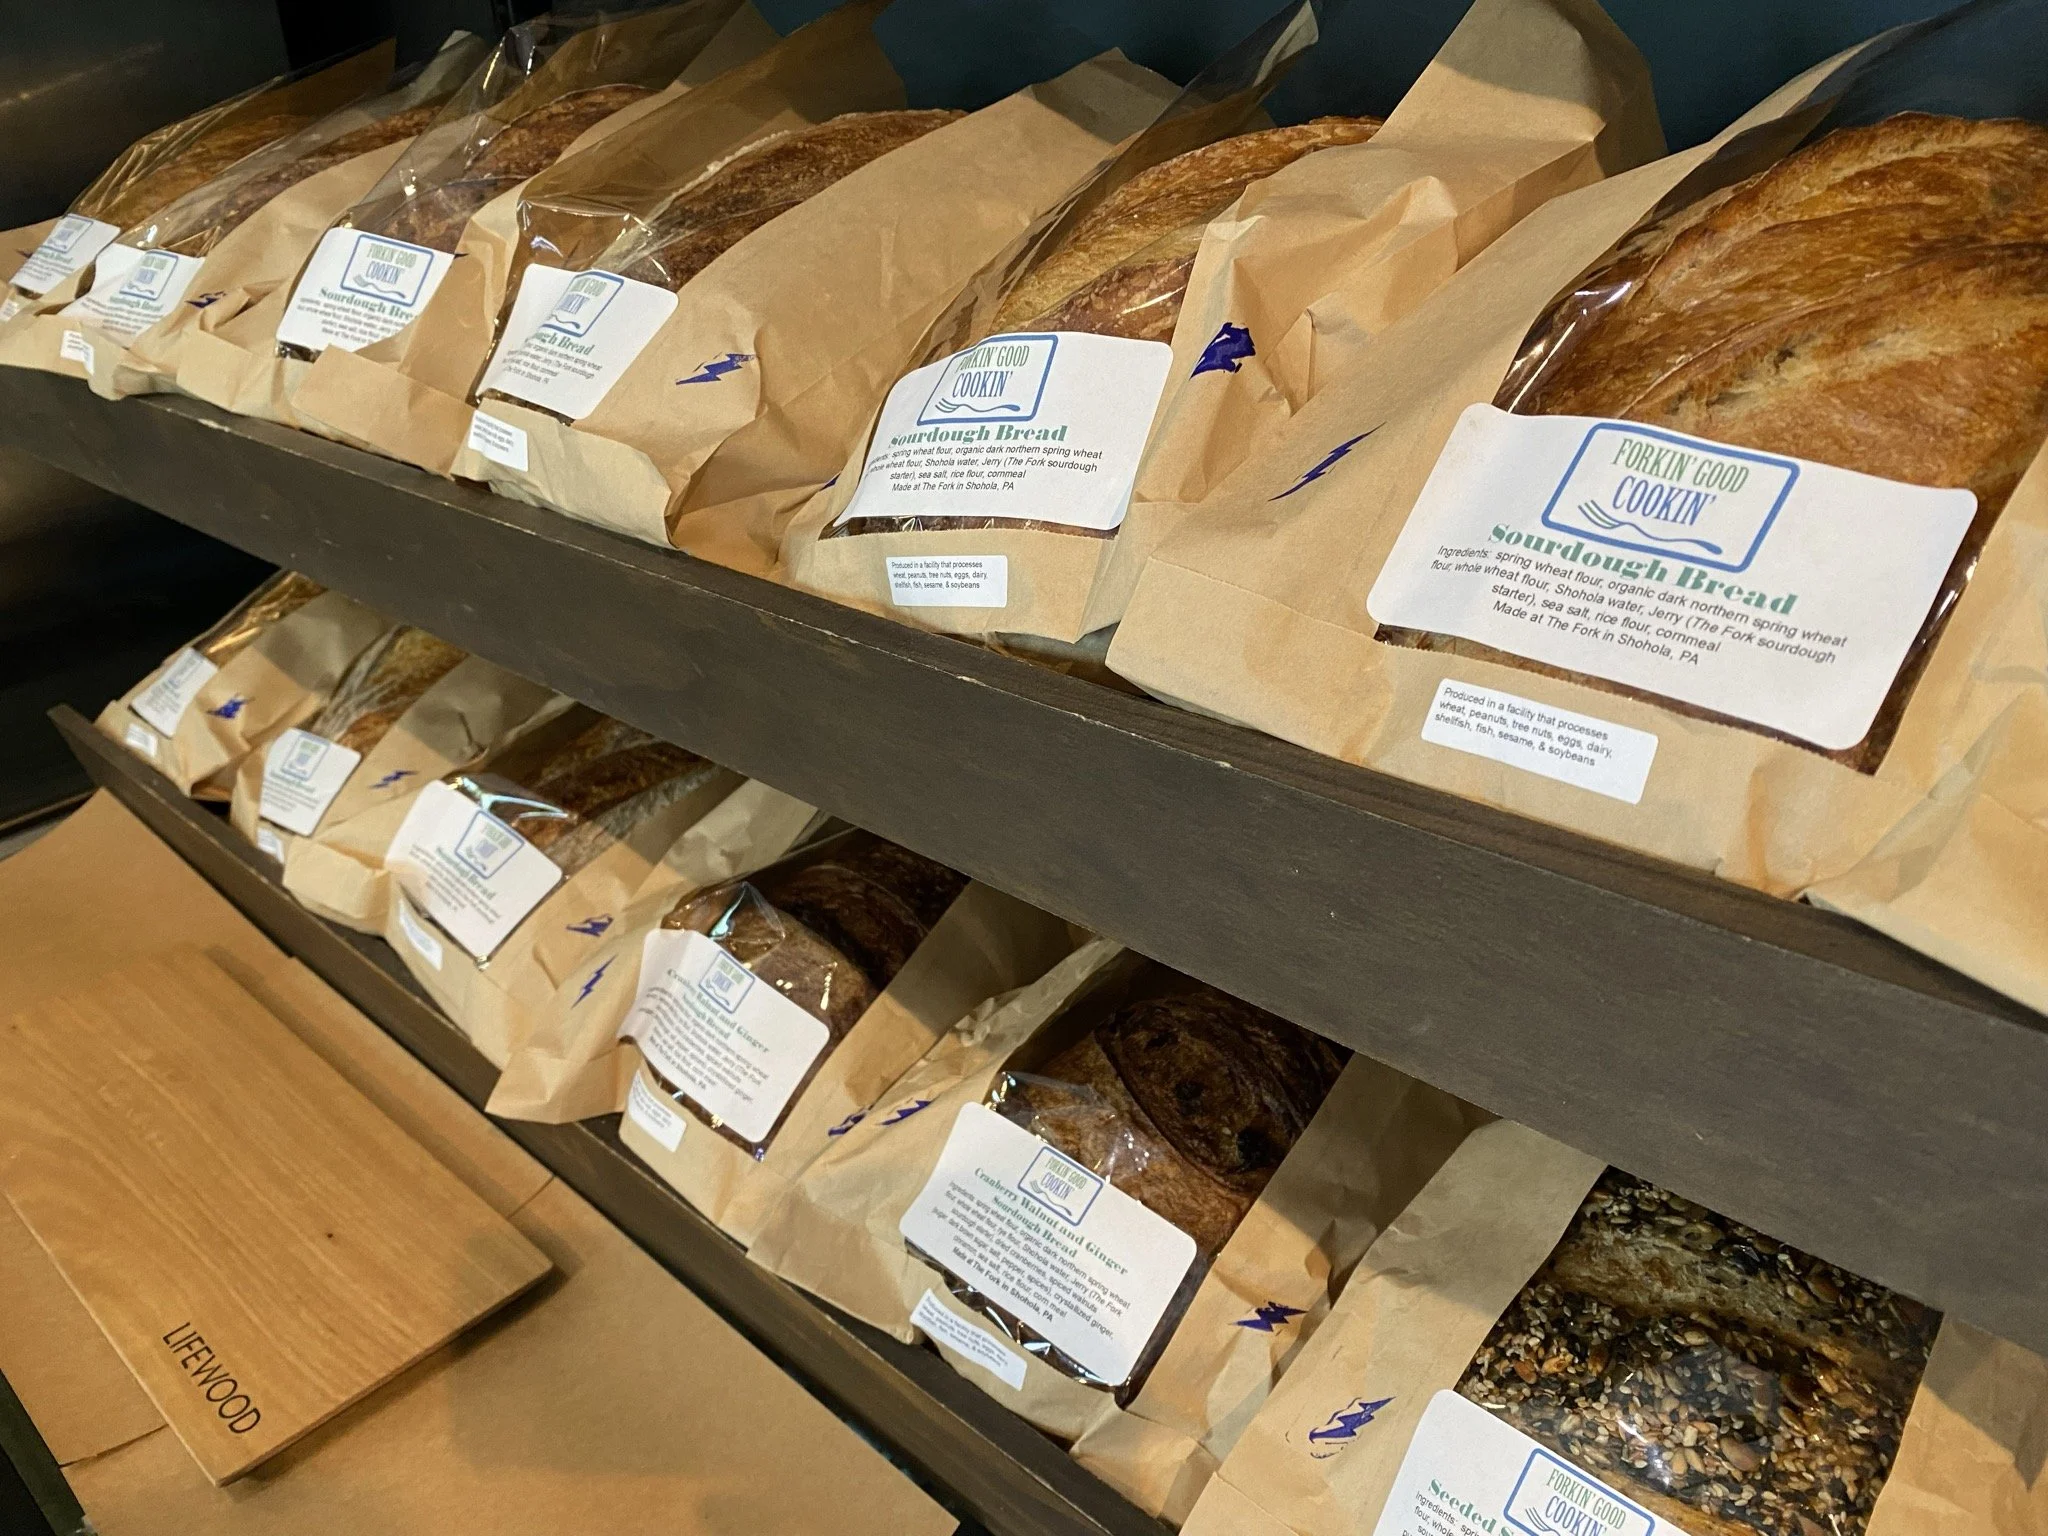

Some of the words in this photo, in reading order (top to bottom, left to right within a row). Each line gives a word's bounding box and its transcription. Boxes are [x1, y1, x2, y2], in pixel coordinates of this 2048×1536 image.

[558, 336, 595, 356] Bread
[996, 345, 1030, 368] GOOD
[952, 371, 1014, 398] COOKIN'
[888, 425, 990, 449] Sourdough
[995, 424, 1068, 442] Bread
[912, 446, 935, 456] wheat
[935, 446, 953, 456] flour,
[955, 445, 985, 456] organic
[985, 444, 1004, 454] dark
[1005, 445, 1041, 454] northern
[1042, 446, 1071, 458] spring
[1073, 448, 1103, 460] wheat
[892, 482, 912, 492] Made
[912, 482, 921, 491] at
[922, 481, 937, 490] The
[937, 481, 956, 490] Fork
[955, 481, 964, 490] in
[965, 481, 1000, 491] Shohola,
[1002, 481, 1014, 490] PA
[906, 459, 923, 468] flour,
[924, 458, 955, 467] Shohola
[956, 458, 979, 467] water,
[981, 457, 1003, 468] Jerry
[1003, 457, 1024, 468] (The
[1024, 457, 1047, 467] Fork
[1047, 460, 1098, 472] sourdough
[932, 470, 948, 479] salt,
[950, 469, 965, 478] rice
[966, 469, 985, 479] flour,
[1611, 438, 1698, 482] FORKIN'
[1692, 458, 1750, 493] GOOD
[1612, 475, 1717, 526] COOKIN'
[940, 560, 952, 568] that
[952, 561, 983, 569] processes
[945, 580, 950, 588] &
[950, 581, 980, 590] soybeans
[1488, 524, 1668, 583] Sourdough
[1674, 566, 1798, 616] Bread
[1430, 559, 1453, 572] flour,
[1454, 561, 1483, 573] whole
[1483, 565, 1520, 582] wheat
[1520, 573, 1550, 593] flour,
[1554, 583, 1605, 604] Shohola
[1608, 597, 1645, 616] water,
[1648, 606, 1684, 626] Jerry
[1685, 615, 1720, 634] (The
[1720, 625, 1756, 644] Fork
[1756, 637, 1836, 664] sourdough
[1437, 545, 1492, 559] Ingredients:
[1495, 552, 1533, 570] spring
[1534, 561, 1574, 580] wheat
[1574, 571, 1604, 589] flour,
[1607, 580, 1656, 599] organic
[1657, 590, 1688, 608] dark
[1689, 600, 1750, 624] northern
[1752, 618, 1799, 639] spring
[1801, 630, 1848, 648] wheat
[1491, 584, 1536, 607] starter),
[1540, 599, 1564, 612] sea
[1566, 606, 1591, 621] salt,
[1594, 611, 1618, 626] rice
[1620, 616, 1652, 636] flour,
[1655, 627, 1722, 652] cornmeal
[1492, 600, 1528, 619] Made
[1529, 613, 1544, 624] at
[1547, 615, 1570, 631] The
[1571, 622, 1602, 639] Fork
[1602, 629, 1615, 642] in
[1617, 632, 1673, 660] Shohola,
[1679, 650, 1699, 666] PA
[1434, 712, 1472, 732] shellfish,
[1475, 722, 1496, 738] fish,
[1497, 730, 1535, 750] sesame,
[1538, 741, 1546, 752] &
[1547, 745, 1595, 766] soybeans
[1440, 701, 1466, 716] wheat,
[1468, 709, 1509, 728] peanuts,
[1512, 719, 1530, 733] tree
[1531, 726, 1554, 742] nuts,
[1557, 734, 1583, 750] eggs,
[1586, 741, 1612, 759] dairy,
[1443, 687, 1486, 706] Produced
[1486, 697, 1496, 709] in
[1497, 703, 1505, 711] a
[1506, 703, 1536, 721] facility
[1536, 712, 1556, 726] that
[1556, 720, 1608, 741] processes
[1040, 1172, 1076, 1201] COOKIN'
[974, 1167, 1019, 1202] Cranberry
[1020, 1196, 1060, 1229] Walnut
[1058, 1226, 1085, 1246] and
[1085, 1242, 1128, 1275] Ginger
[992, 1195, 1042, 1235] Sourdough
[1041, 1229, 1078, 1258] Bread
[1019, 1229, 1043, 1248] organic
[1042, 1245, 1058, 1260] dark
[1087, 1276, 1109, 1295] spring
[1022, 1243, 1050, 1267] Shohola
[1070, 1278, 1090, 1294] Jerry
[984, 1269, 1001, 1286] Fork
[1001, 1280, 1010, 1292] in
[1010, 1287, 1040, 1315] Shohola,
[1042, 1310, 1053, 1322] PA
[162, 1322, 261, 1434] LIFEWOOD
[1413, 1506, 1430, 1526] flour,
[1415, 1491, 1458, 1526] Ingredients:
[1428, 1478, 1496, 1534] Seeded
[1546, 1468, 1595, 1510] FORKIN'
[1592, 1498, 1626, 1530] GOOD
